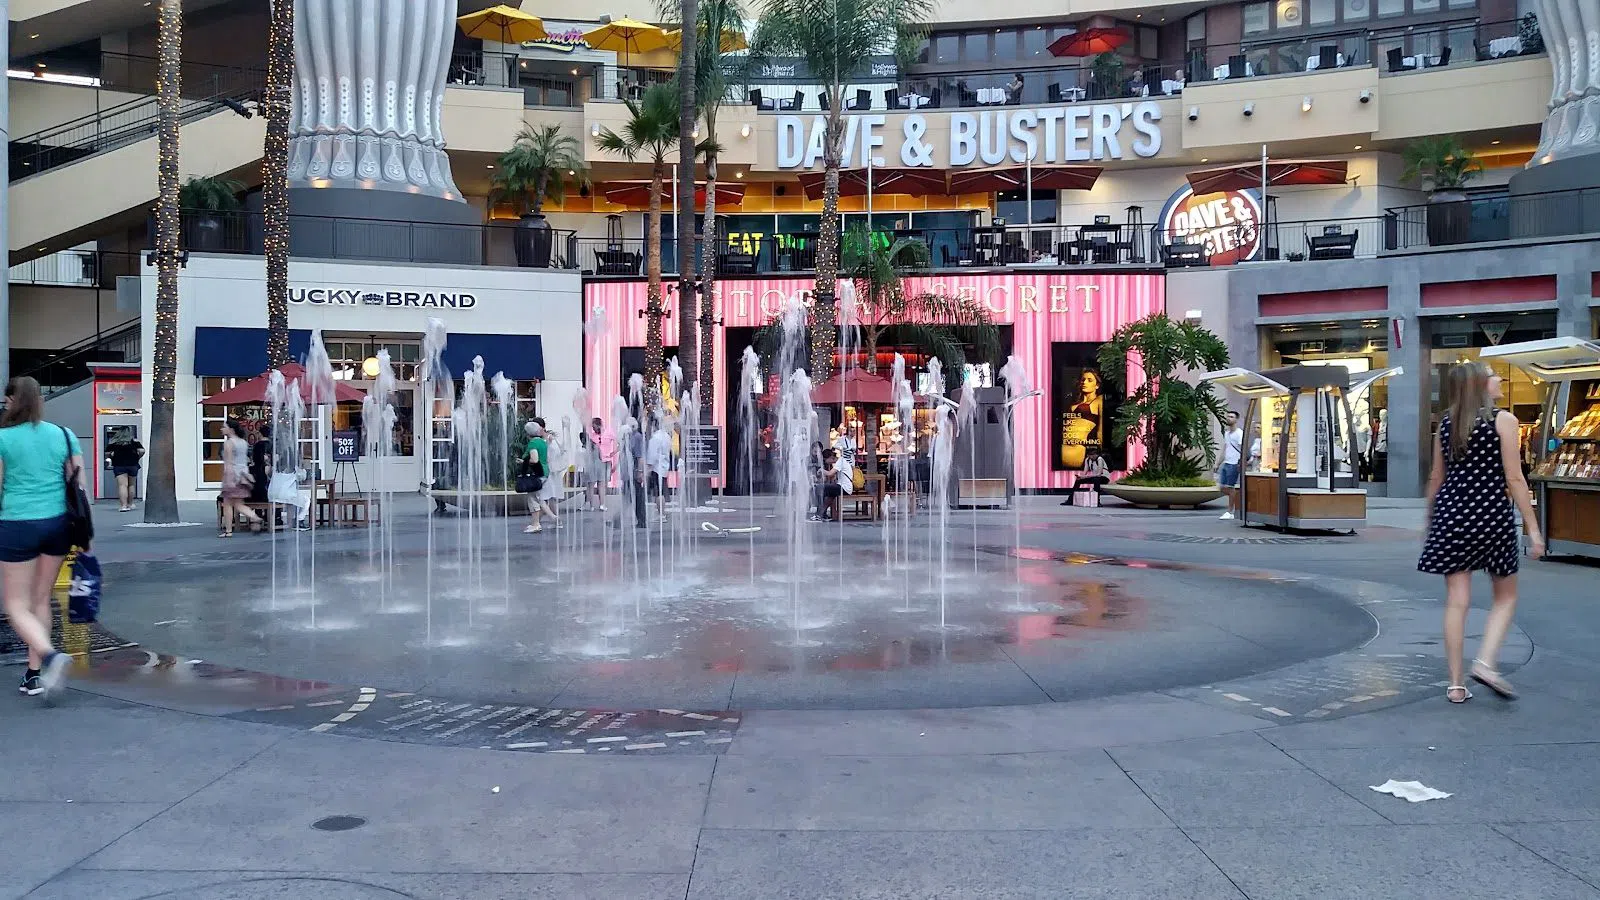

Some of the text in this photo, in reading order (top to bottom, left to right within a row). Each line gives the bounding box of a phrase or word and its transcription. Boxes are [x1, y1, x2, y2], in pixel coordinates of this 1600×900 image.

[777, 101, 1162, 168] DAVE & BUSTER'S
[1174, 196, 1253, 236] DAVE &
[728, 232, 764, 257] EAT
[288, 288, 476, 308] UCKY BRAND
[246, 409, 266, 420] SAL
[338, 437, 354, 446] 50%
[338, 446, 354, 455] OFF
